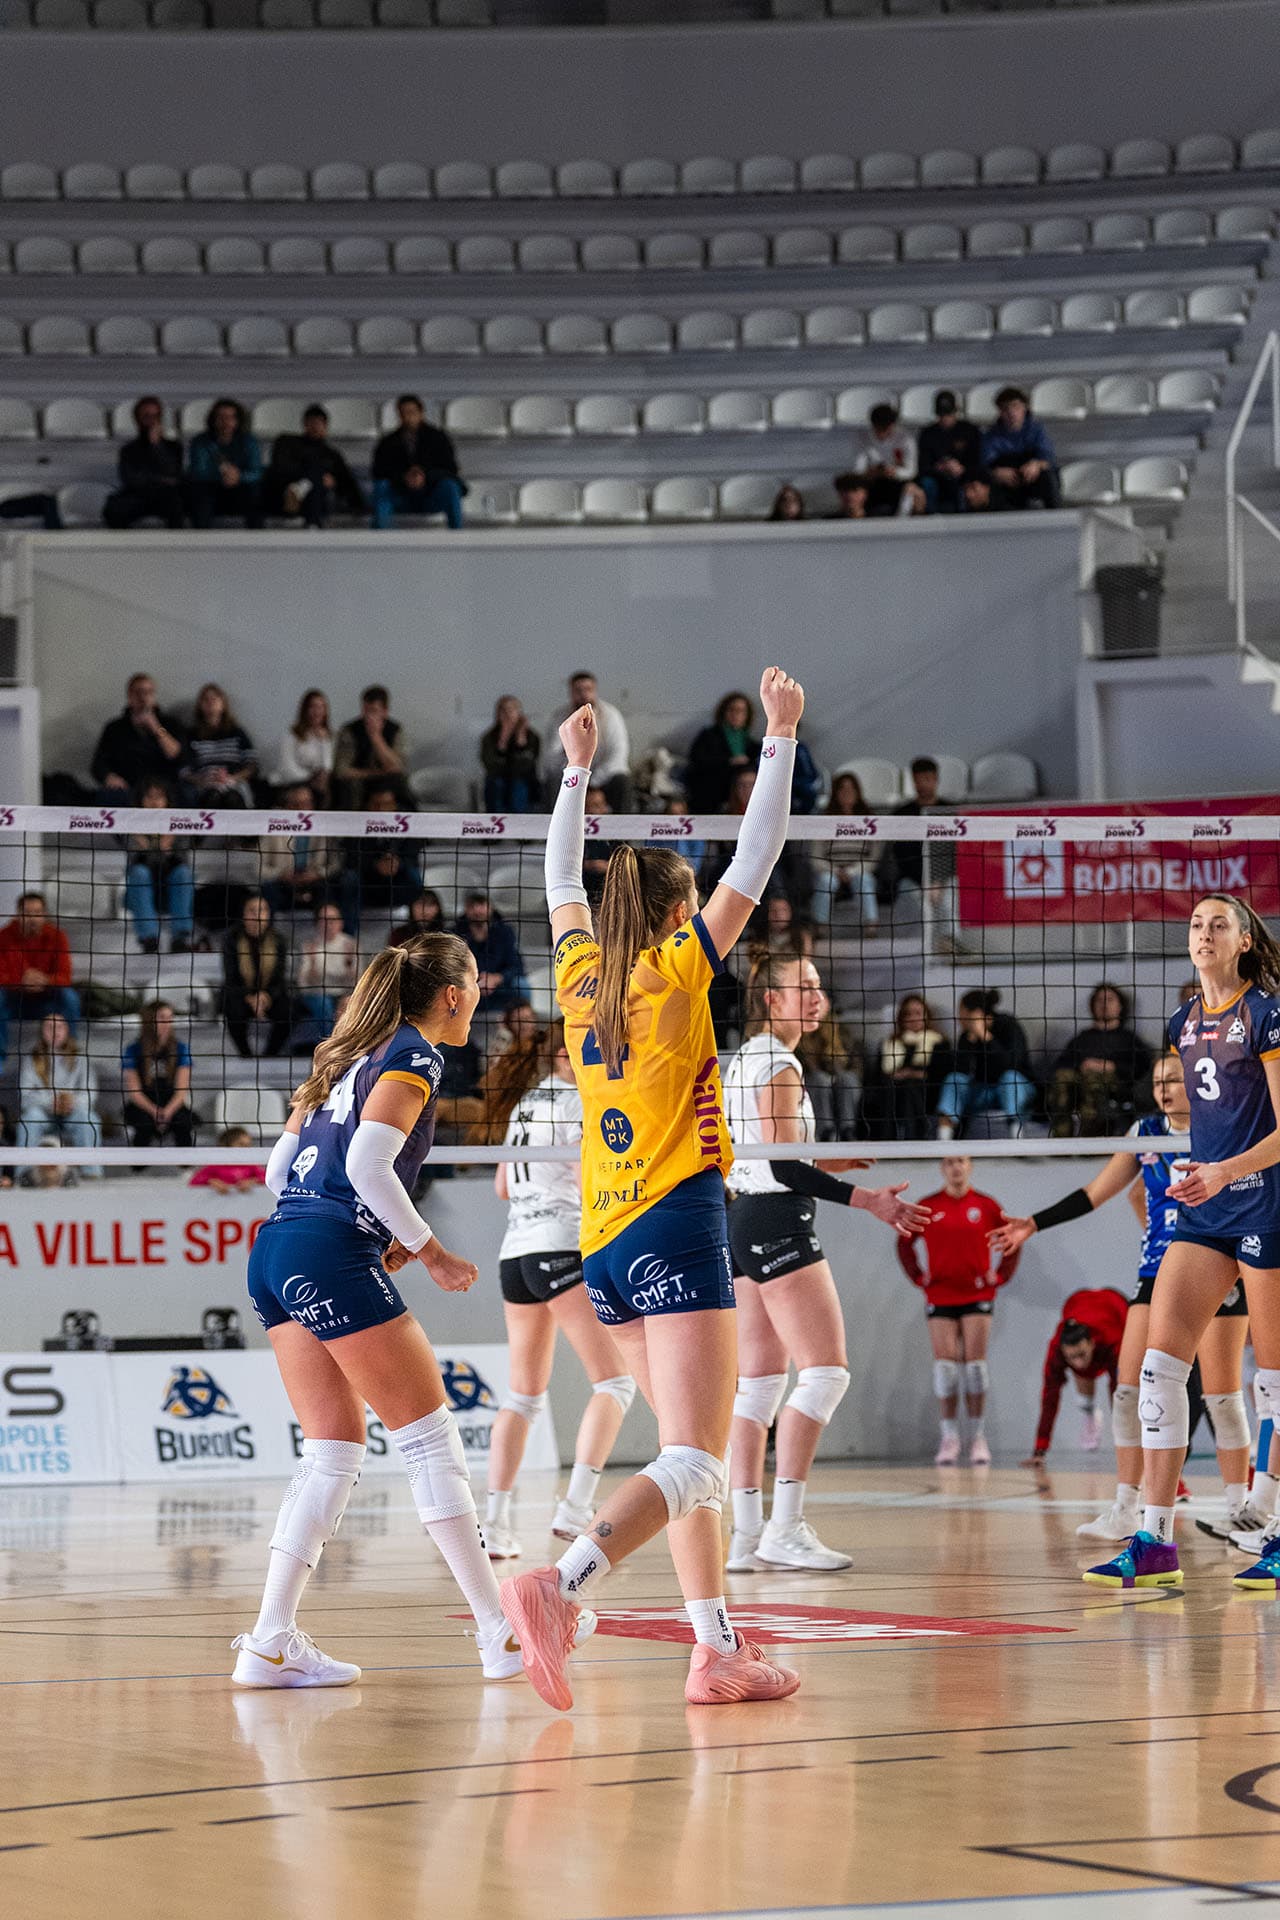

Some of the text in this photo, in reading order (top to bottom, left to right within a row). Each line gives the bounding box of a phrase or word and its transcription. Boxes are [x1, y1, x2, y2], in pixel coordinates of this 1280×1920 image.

[1073, 855, 1248, 897] BORDEAUX
[1194, 1057, 1221, 1100] 3
[605, 1117, 624, 1130] MT
[692, 1056, 722, 1170] Safor
[608, 1132, 629, 1145] PK
[35, 1221, 167, 1267] VILLE
[369, 1266, 391, 1296] CRAFT
[632, 1273, 684, 1310] CMFT
[290, 1299, 333, 1324] CMFT
[577, 1561, 597, 1586] CRAFT
[717, 1608, 728, 1632] CRAFT
